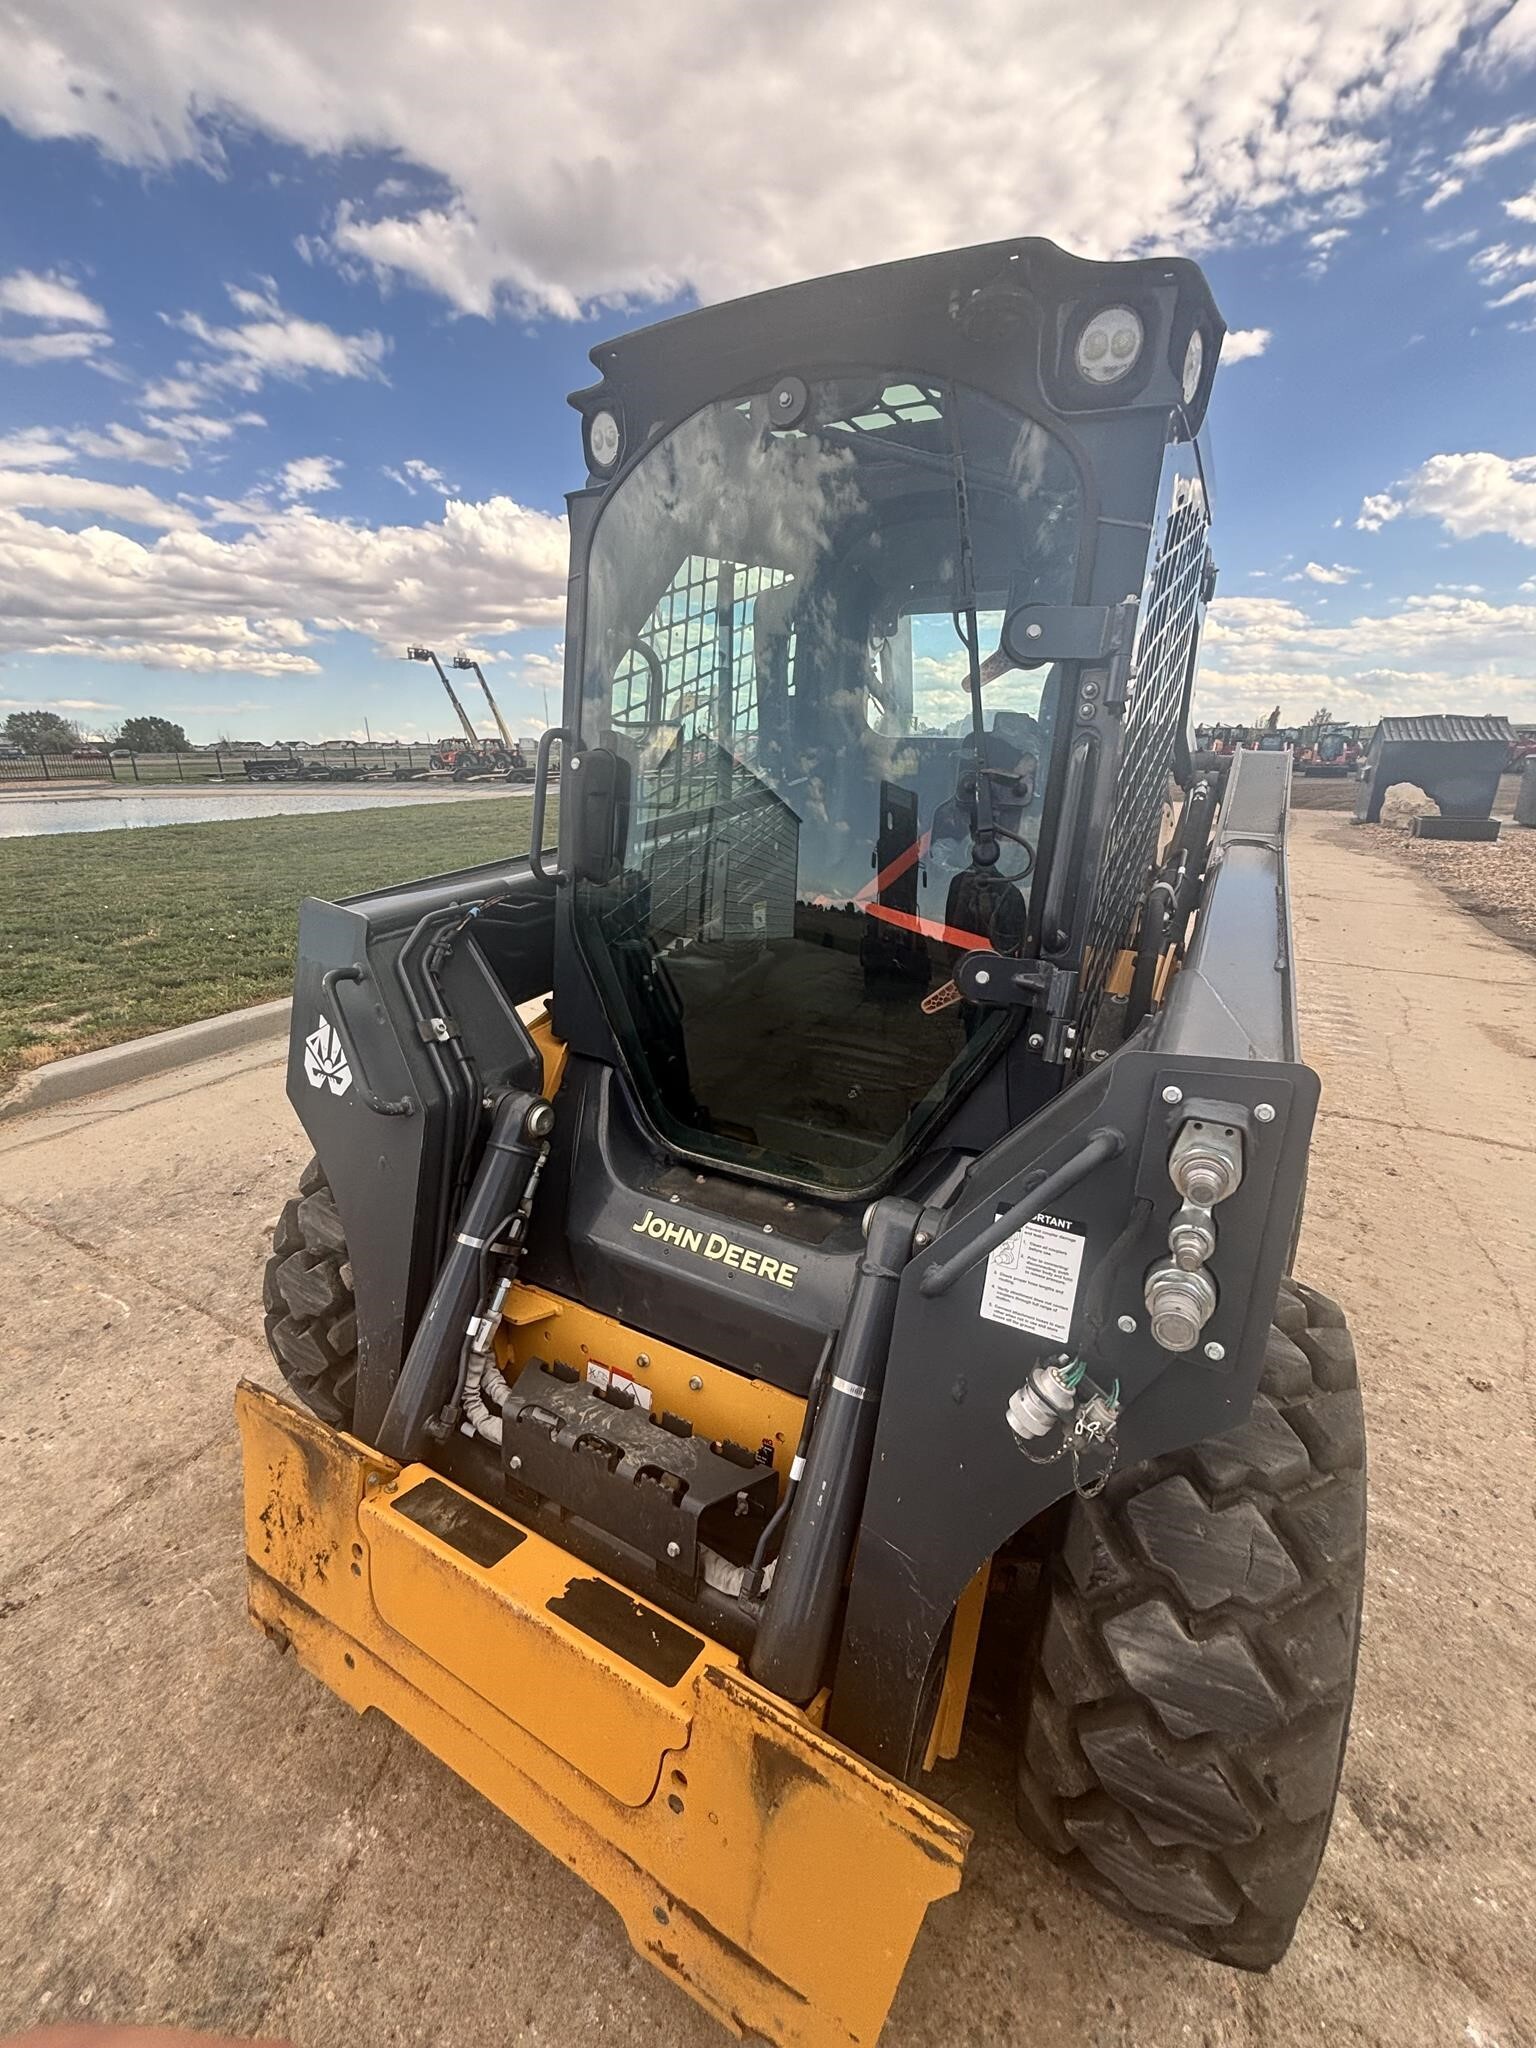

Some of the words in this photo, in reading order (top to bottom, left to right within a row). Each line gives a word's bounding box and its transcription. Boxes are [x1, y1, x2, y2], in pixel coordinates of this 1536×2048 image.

[1031, 1213, 1073, 1230] RTANT
[632, 1209, 704, 1253] JOHN
[703, 1232, 799, 1288] DEERE
